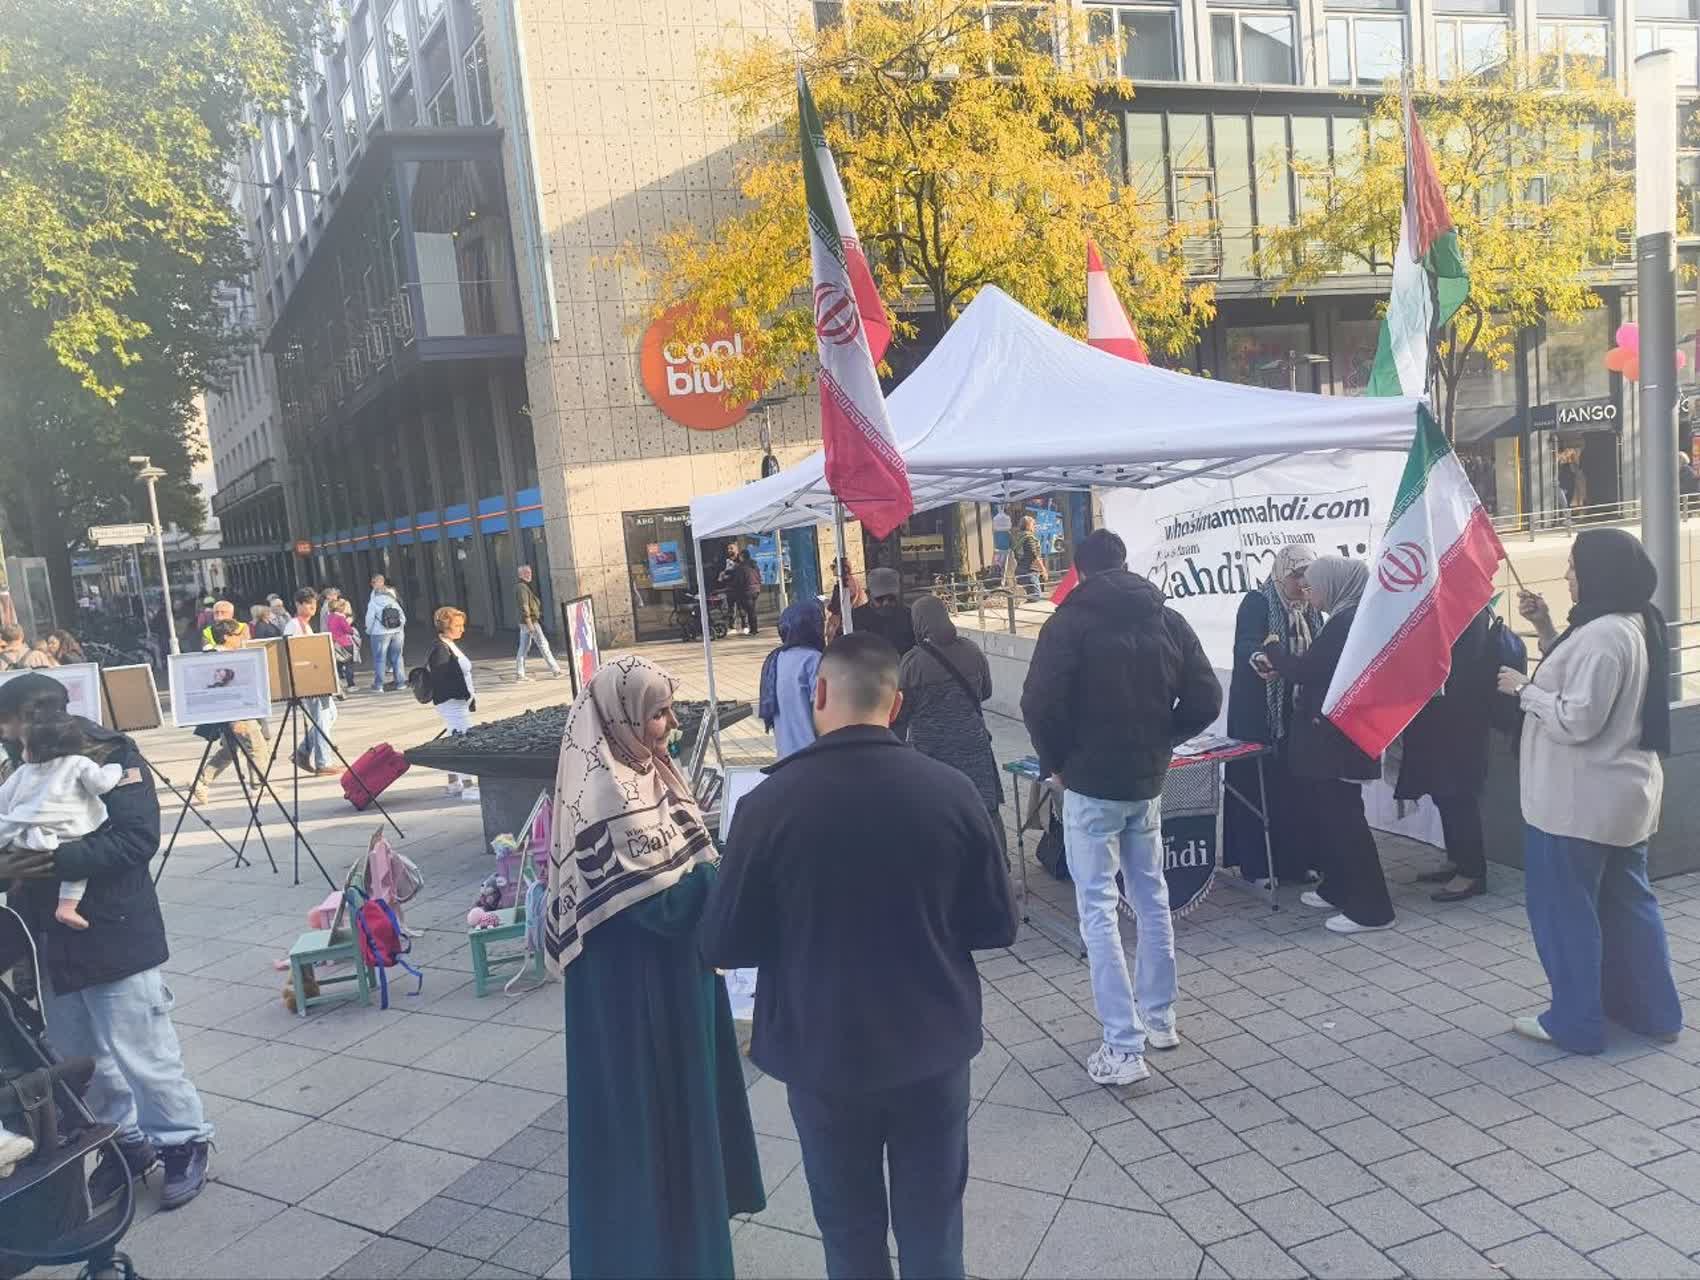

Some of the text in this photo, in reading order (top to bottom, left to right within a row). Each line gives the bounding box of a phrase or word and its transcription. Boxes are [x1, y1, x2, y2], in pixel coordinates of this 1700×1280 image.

[664, 333, 743, 364] cool
[666, 366, 730, 396] blu
[1558, 404, 1617, 423] MANGO
[1243, 532, 1269, 546] Who
[1270, 531, 1281, 545] is
